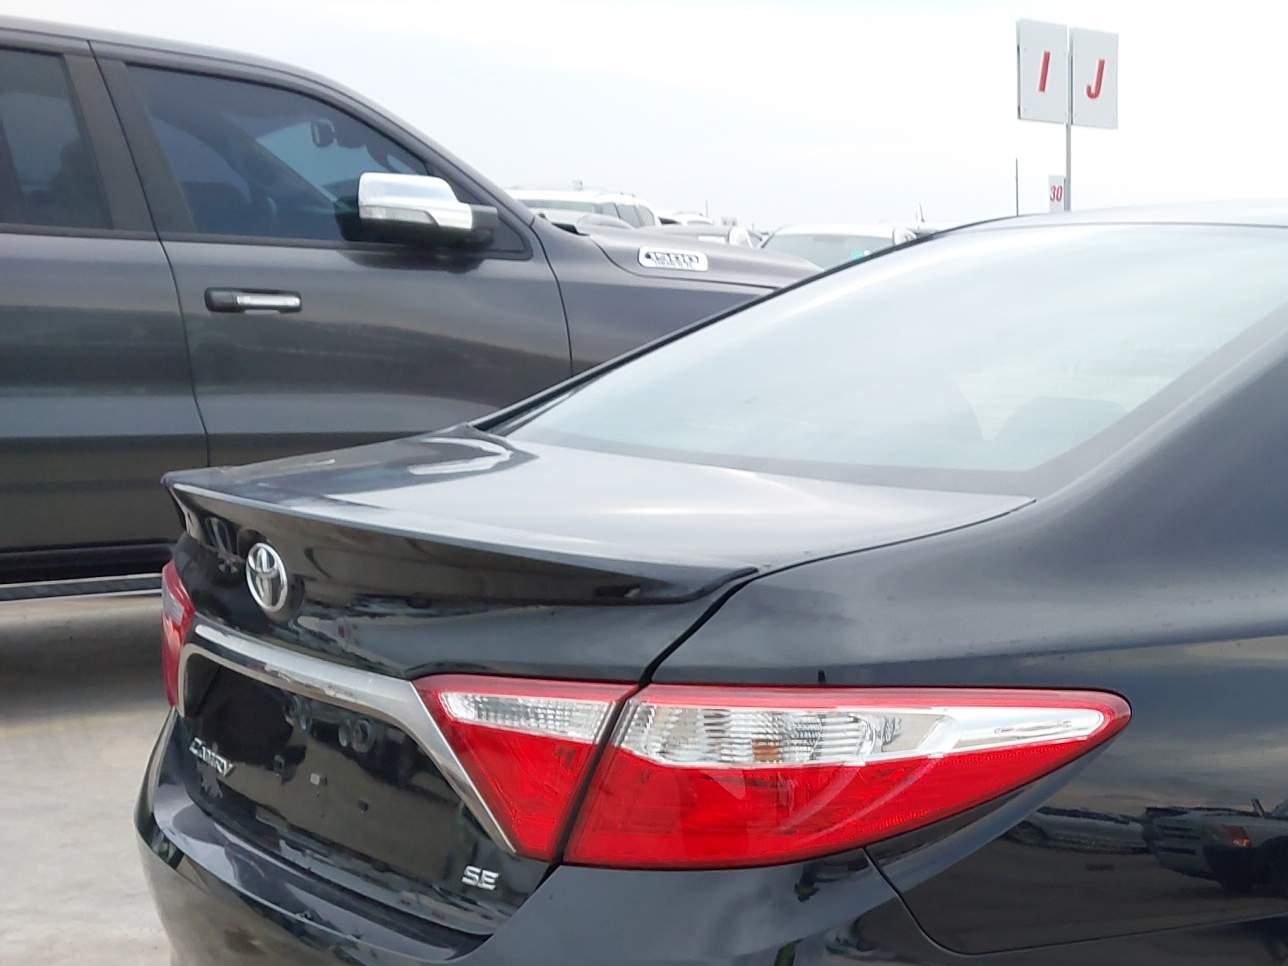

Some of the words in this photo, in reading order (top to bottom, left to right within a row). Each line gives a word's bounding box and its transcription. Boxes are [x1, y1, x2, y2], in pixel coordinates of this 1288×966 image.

[1038, 50, 1051, 93] I
[1086, 59, 1105, 100] J
[1049, 185, 1063, 202] 30
[461, 865, 499, 891] SE
